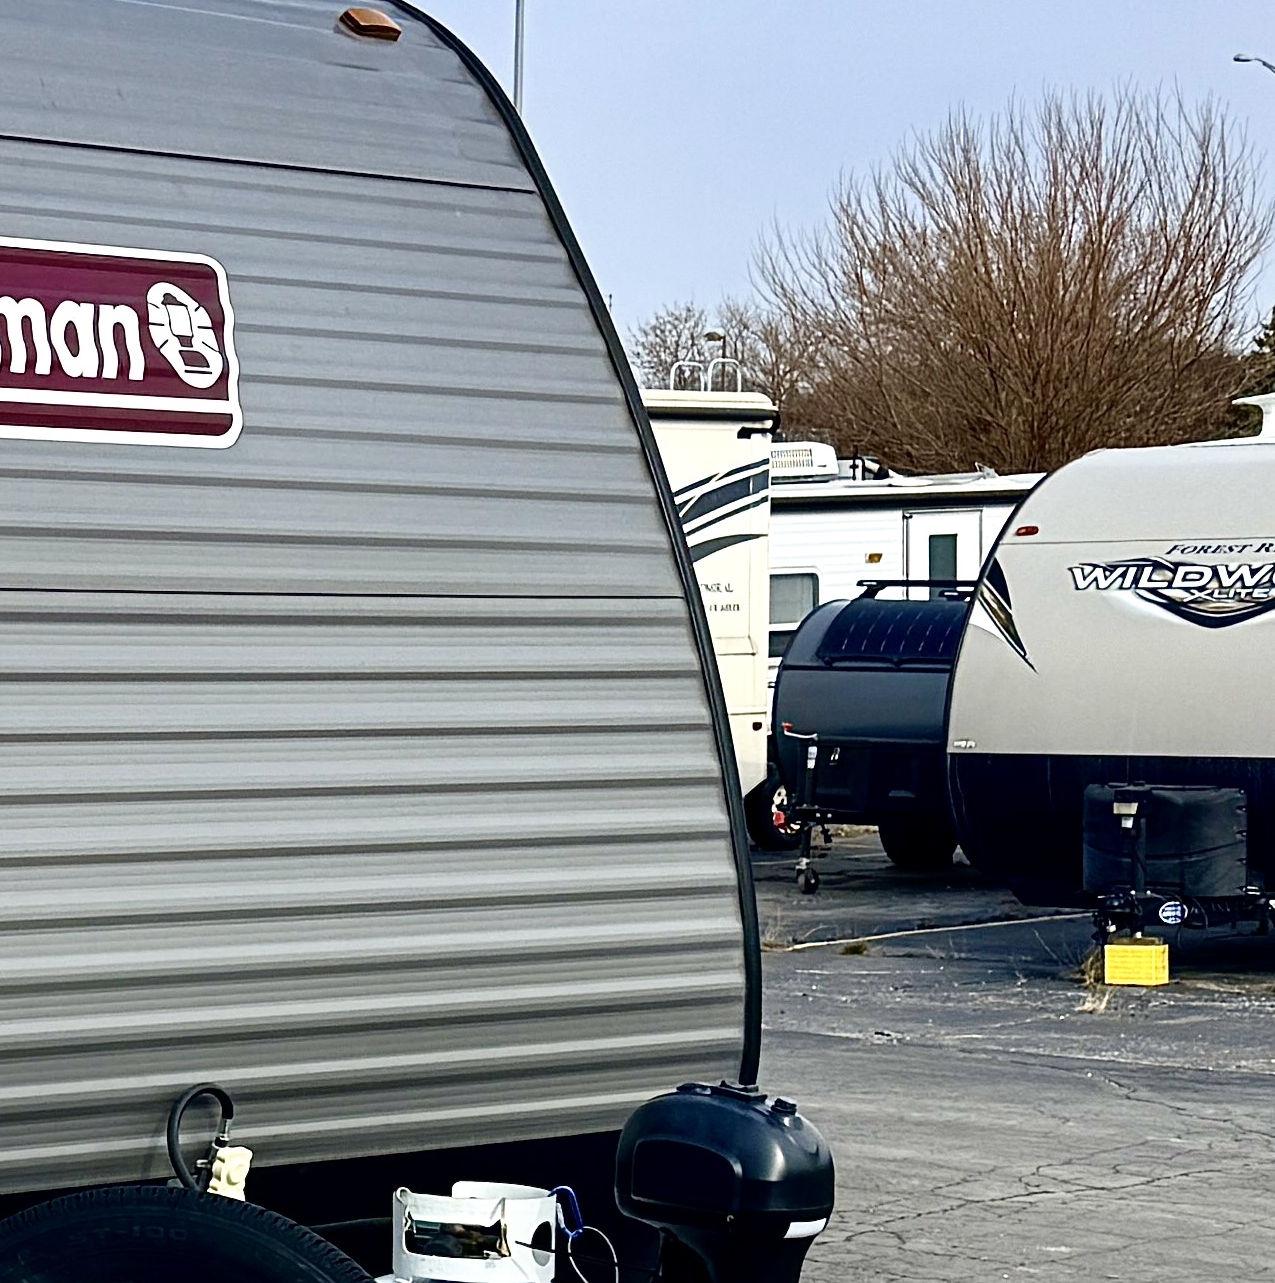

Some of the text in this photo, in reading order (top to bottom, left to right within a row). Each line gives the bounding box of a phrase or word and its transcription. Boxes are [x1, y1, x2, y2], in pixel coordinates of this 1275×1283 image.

[1165, 542, 1275, 555] FOREST R
[1069, 563, 1275, 591] WILDW
